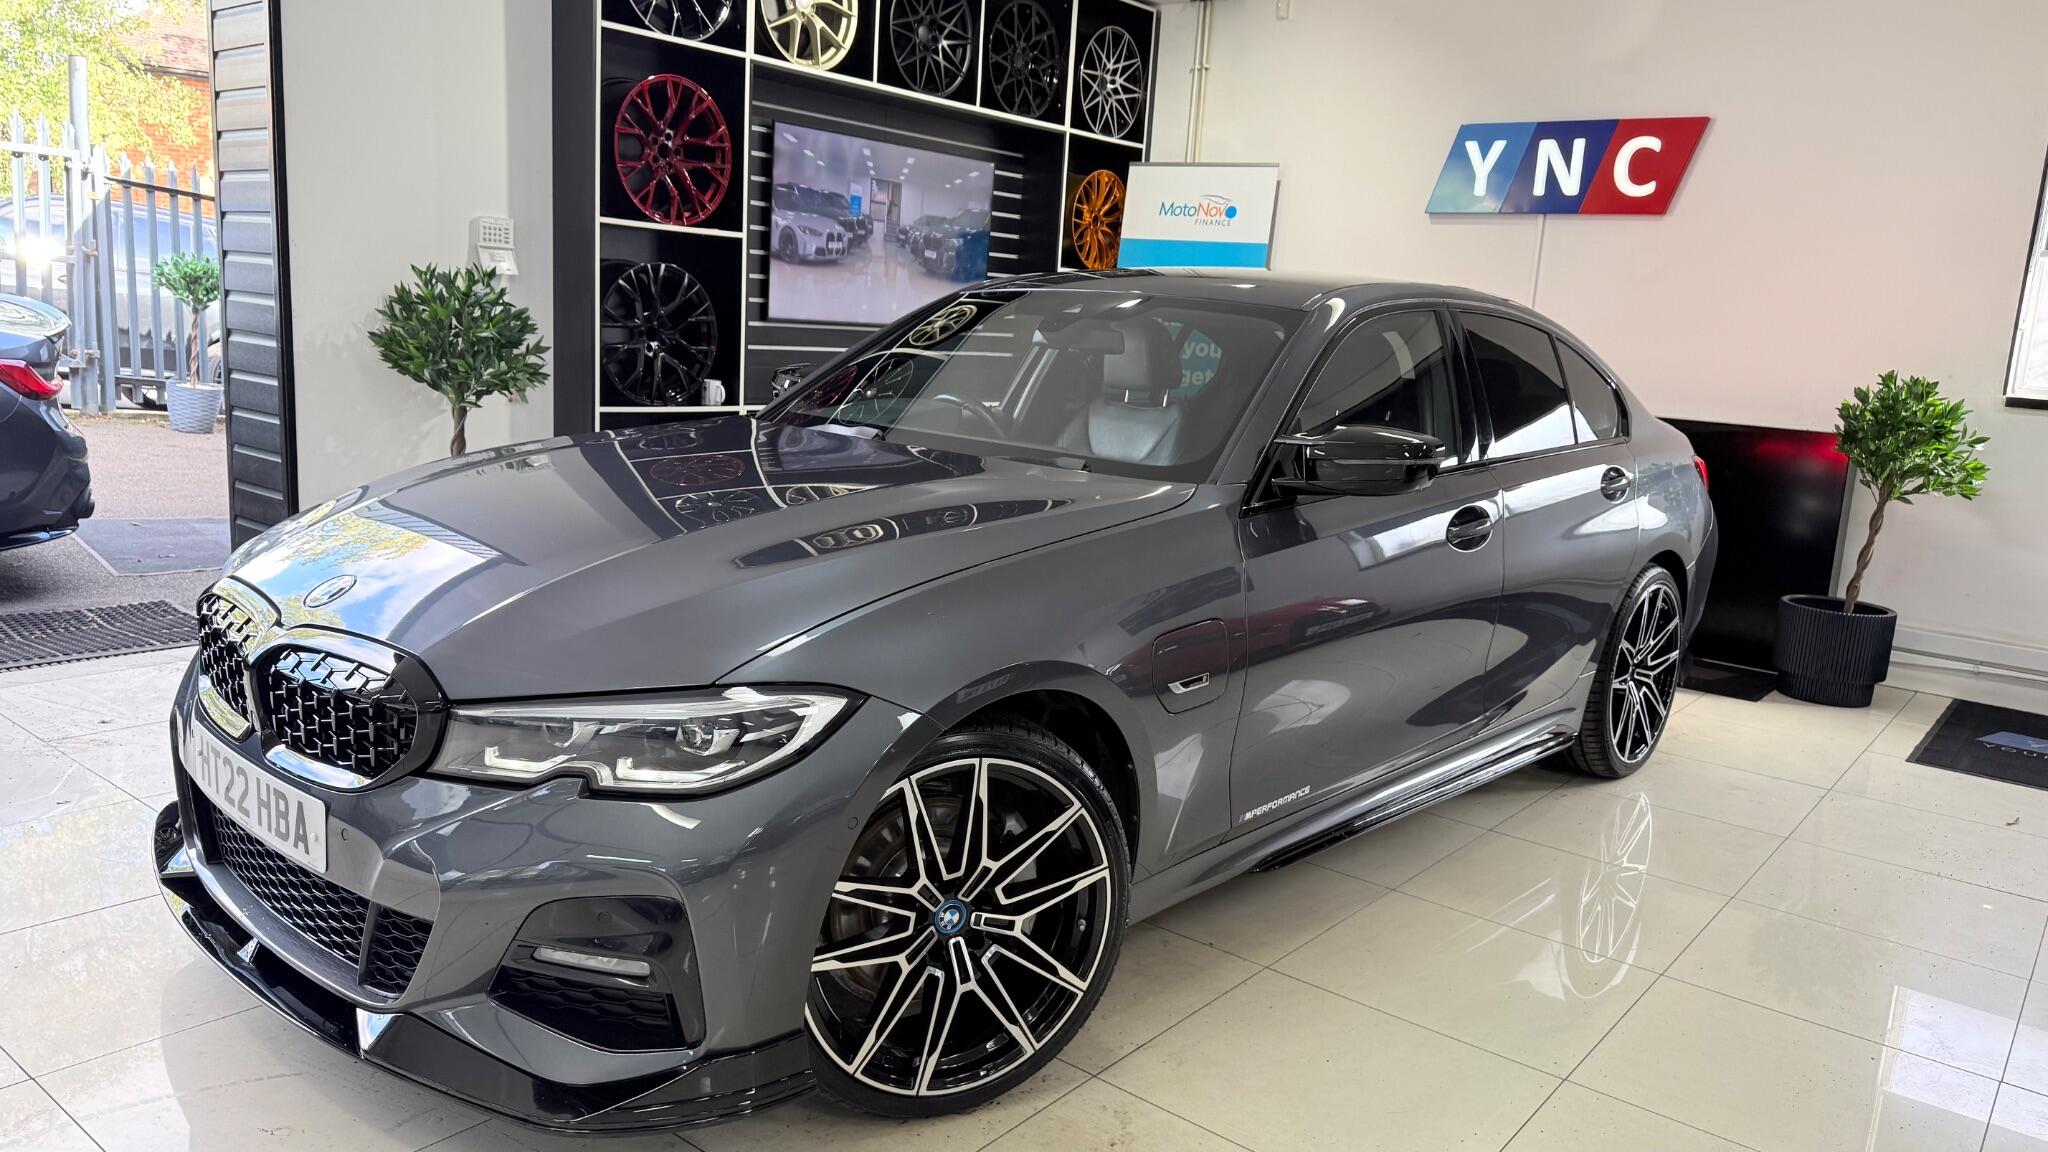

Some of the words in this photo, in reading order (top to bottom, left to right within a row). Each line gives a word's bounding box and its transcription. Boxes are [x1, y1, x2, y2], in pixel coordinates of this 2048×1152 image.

[1464, 135, 1663, 197] YNC
[1159, 201, 1237, 219] MotoNovo
[1194, 219, 1231, 227] FINANCE
[1182, 341, 1222, 359] you
[199, 735, 250, 819] HT22
[256, 777, 310, 856] HBA
